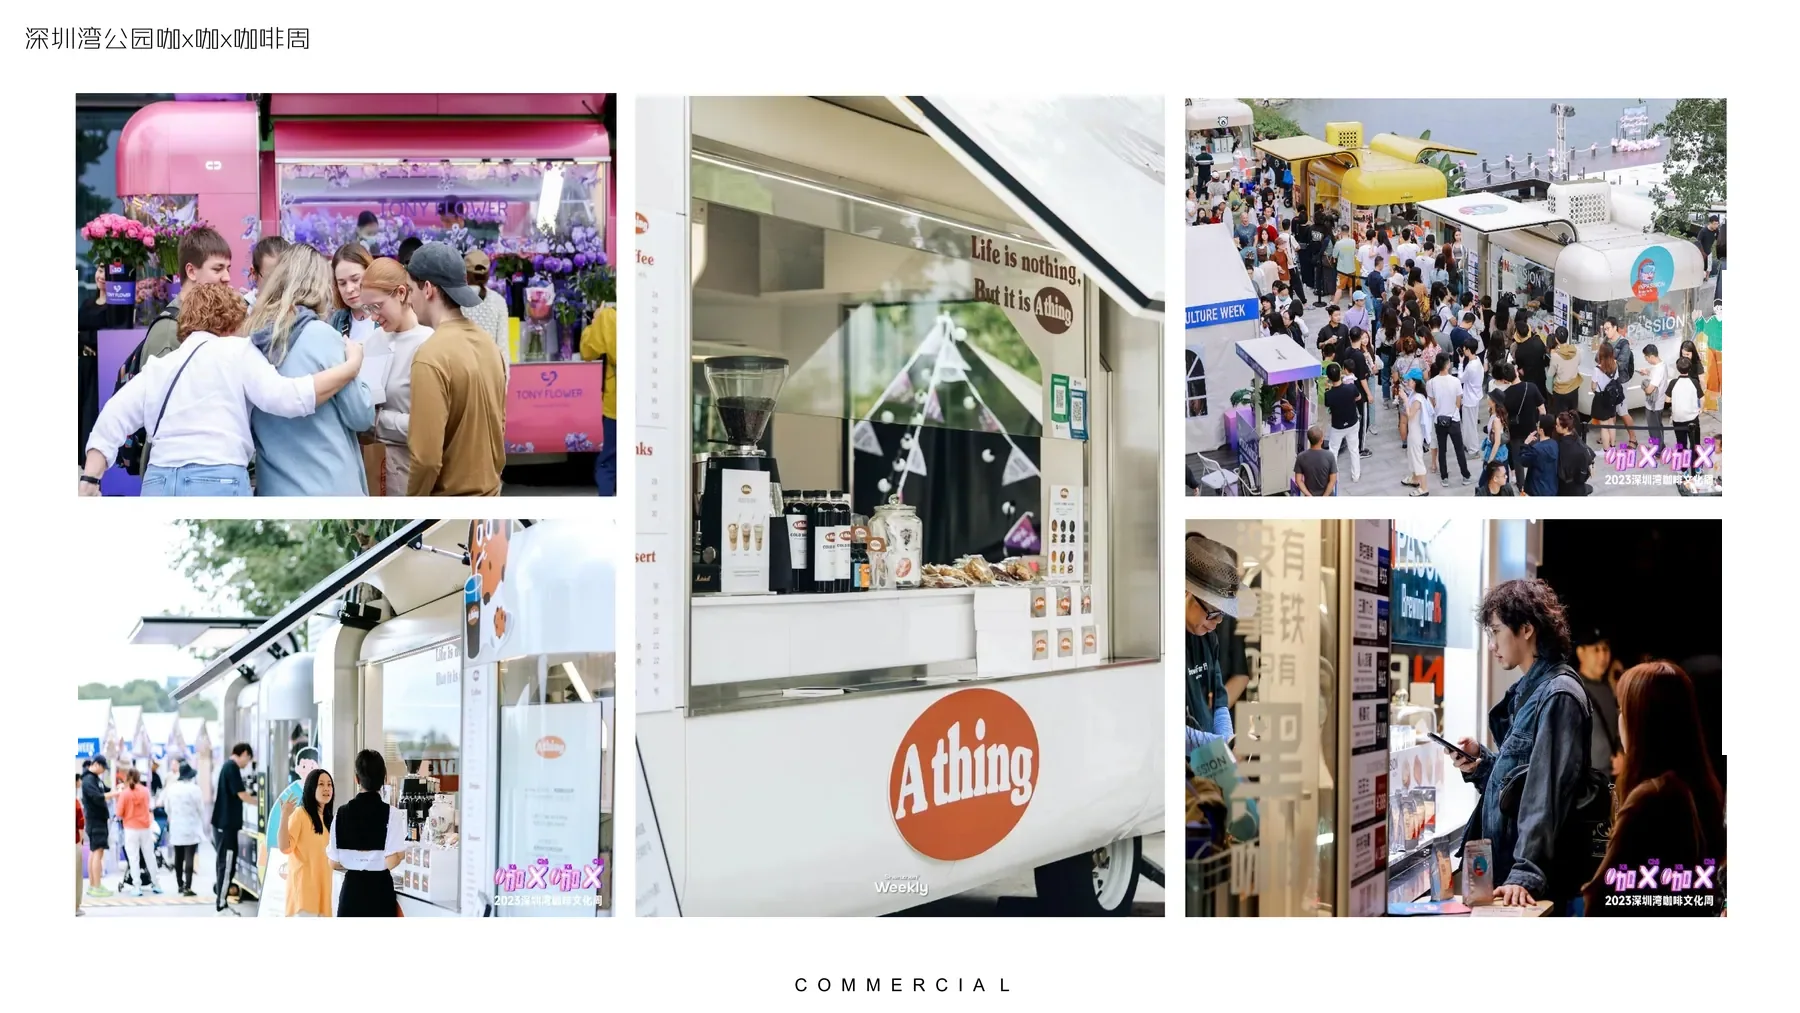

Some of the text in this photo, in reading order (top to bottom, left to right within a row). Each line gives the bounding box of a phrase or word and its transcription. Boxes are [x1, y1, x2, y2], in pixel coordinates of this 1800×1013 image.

[379, 200, 508, 217] TONY FLOWER
[971, 235, 1081, 287] Life is nothing,
[974, 278, 1000, 305] But
[1004, 286, 1015, 309] it
[1019, 289, 1030, 312] is
[1220, 304, 1246, 319] WEEK
[516, 388, 583, 400] TONY FLOWER
